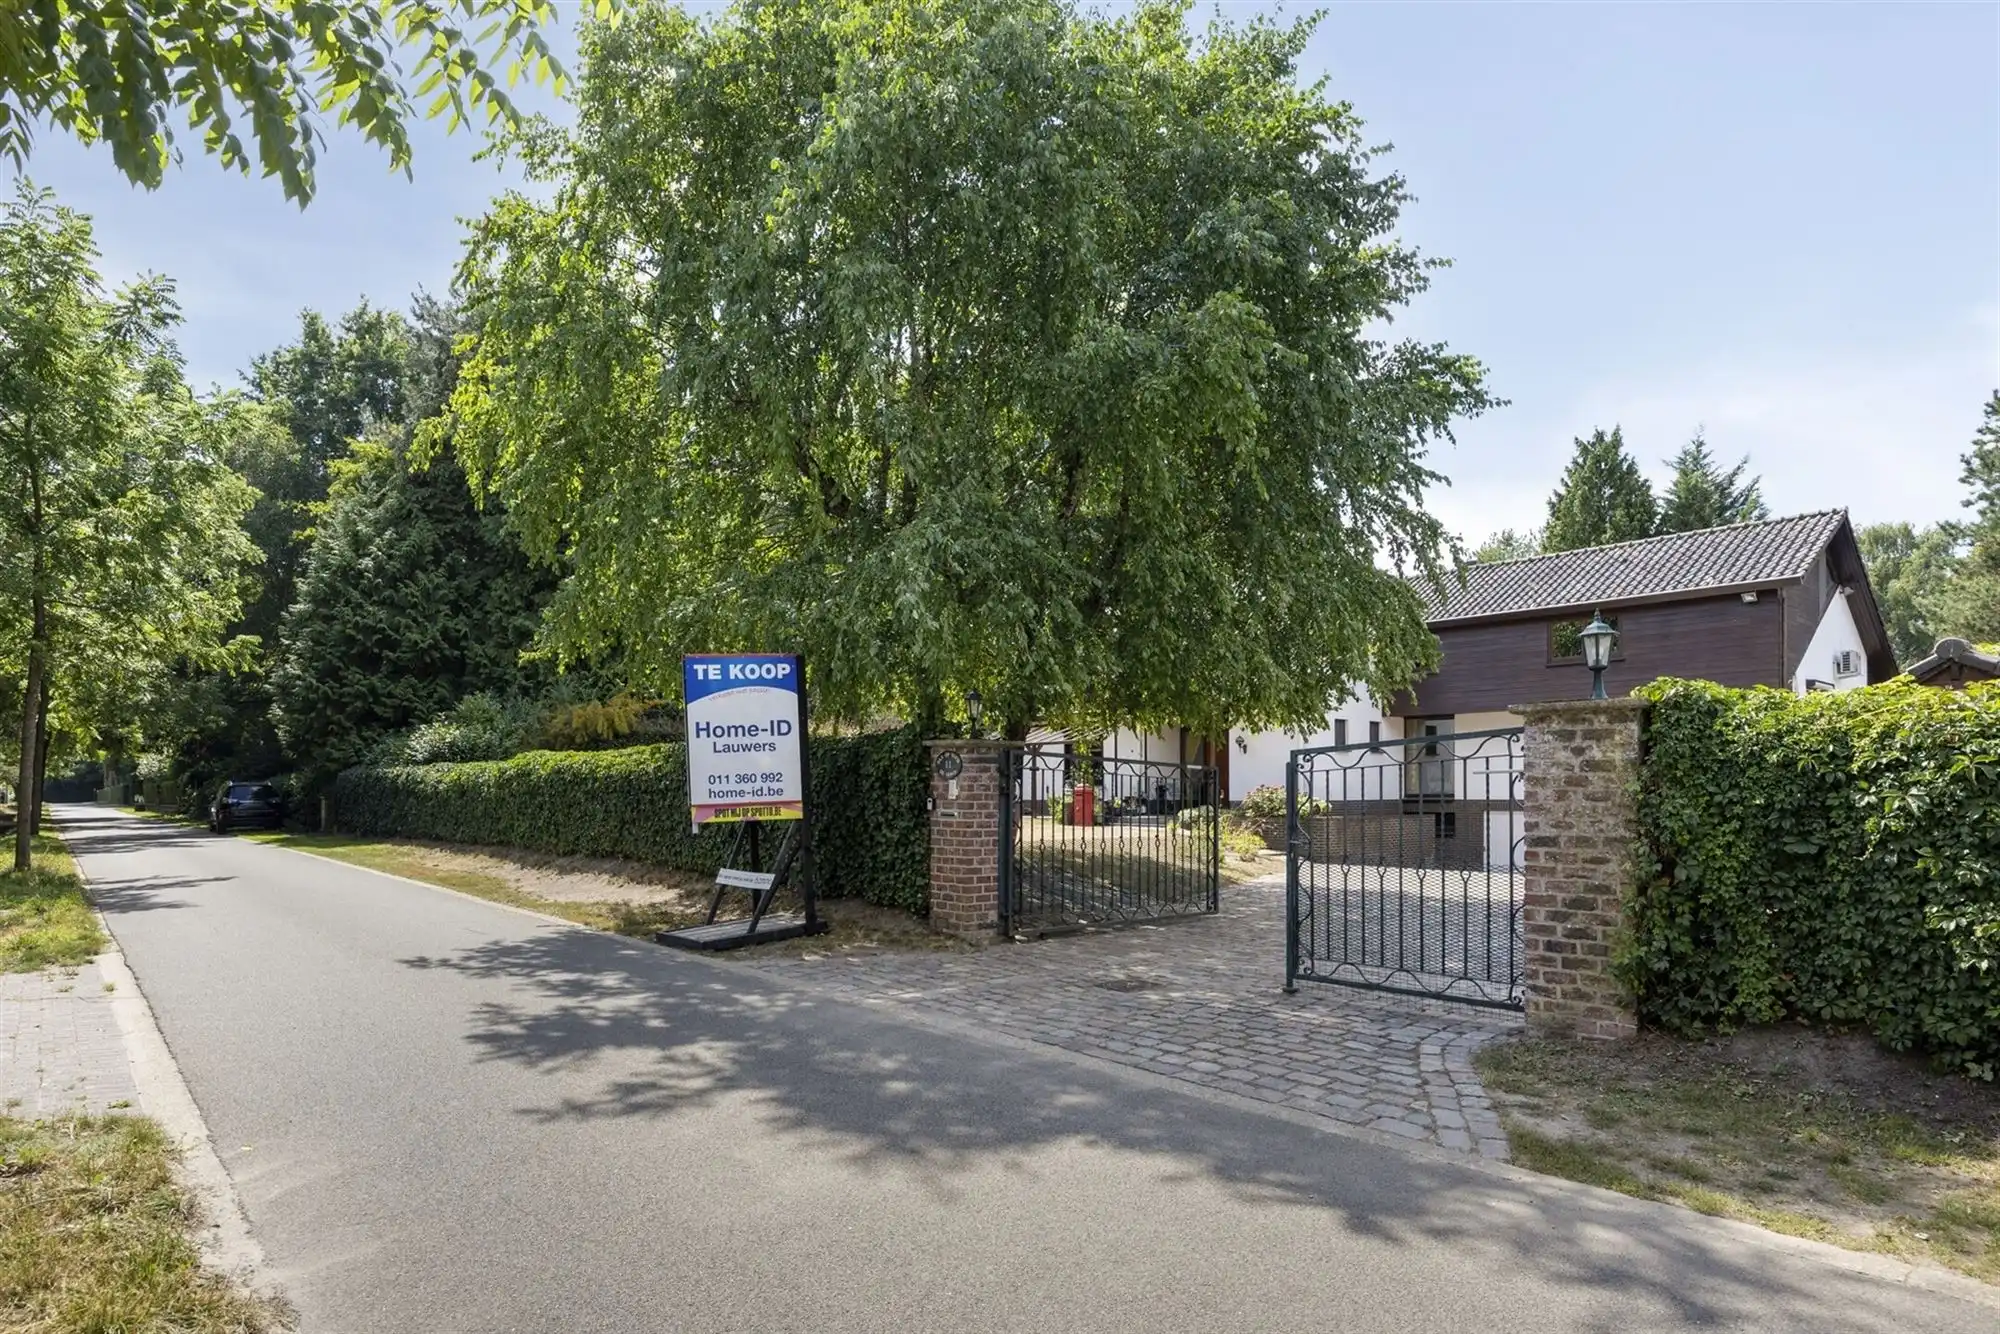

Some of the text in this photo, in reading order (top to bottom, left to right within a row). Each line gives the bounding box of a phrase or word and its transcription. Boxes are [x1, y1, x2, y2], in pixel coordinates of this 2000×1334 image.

[693, 663, 791, 680] TE KOOP
[695, 720, 792, 739] Home-ID
[713, 741, 777, 754] Lauwers
[708, 773, 783, 785] 011 360 992
[708, 786, 784, 799] home-id.be
